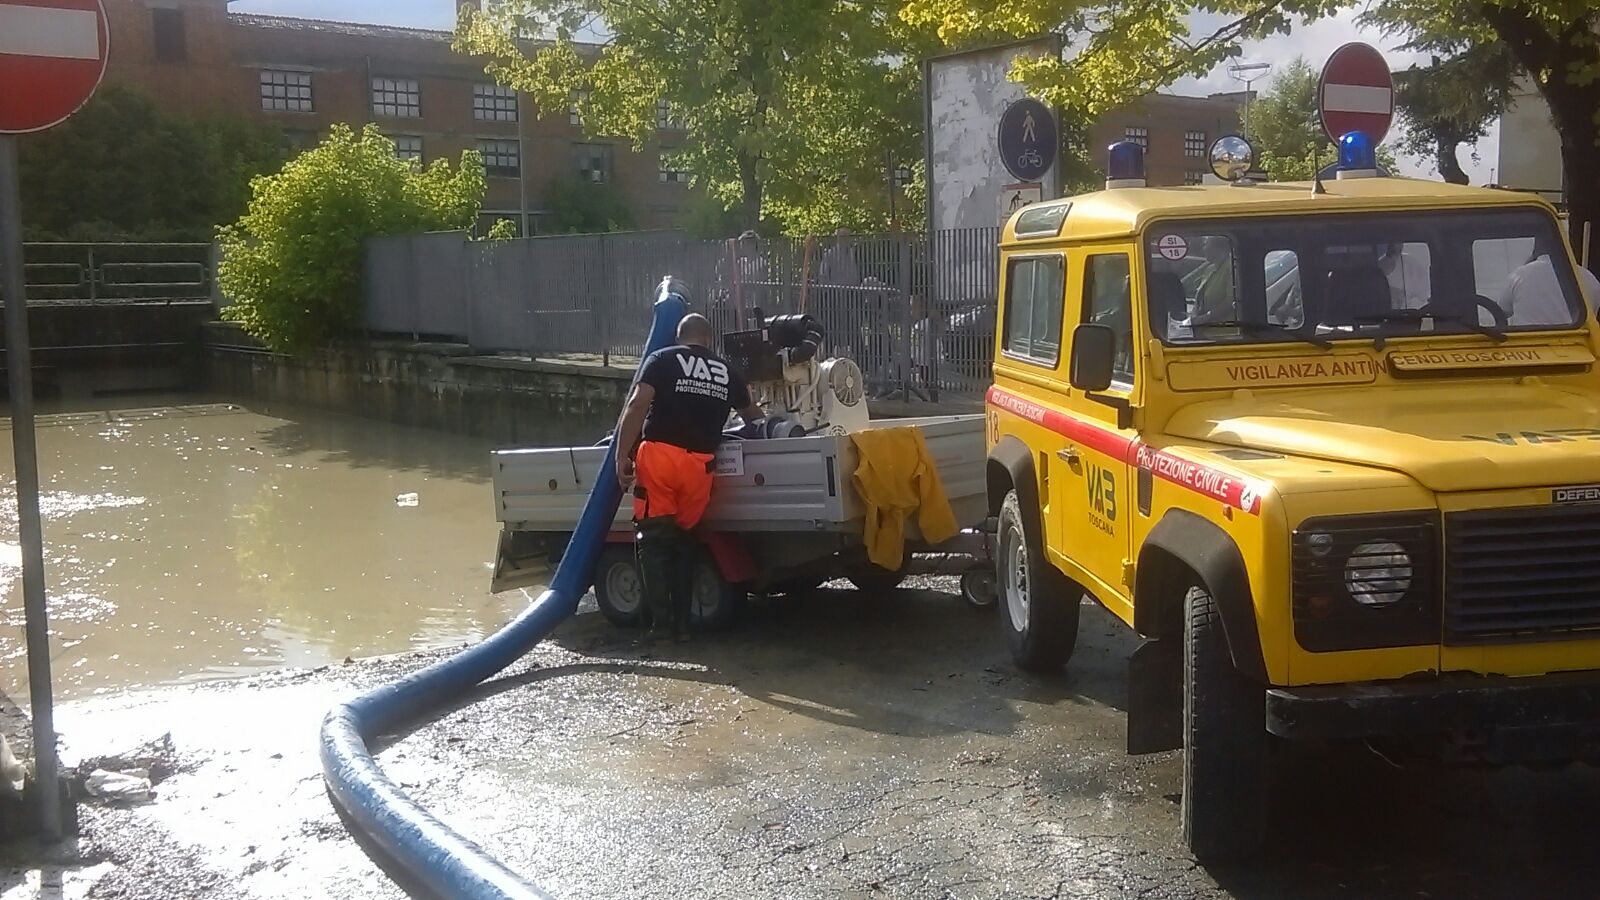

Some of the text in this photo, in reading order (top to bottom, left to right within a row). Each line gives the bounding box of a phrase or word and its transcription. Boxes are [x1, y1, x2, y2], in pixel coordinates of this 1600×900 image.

[676, 353, 729, 385] VAB
[1226, 362, 1328, 381] VIGILANZA
[1450, 350, 1542, 364] BOSCHIVI
[675, 385, 728, 401] PROTEZIONE CIVILE
[676, 379, 729, 395] ANTINCENDIO
[1136, 447, 1232, 498] PROTEZIONE CIVILE
[1085, 460, 1117, 522] VAB
[1088, 511, 1115, 537] TOSCANA
